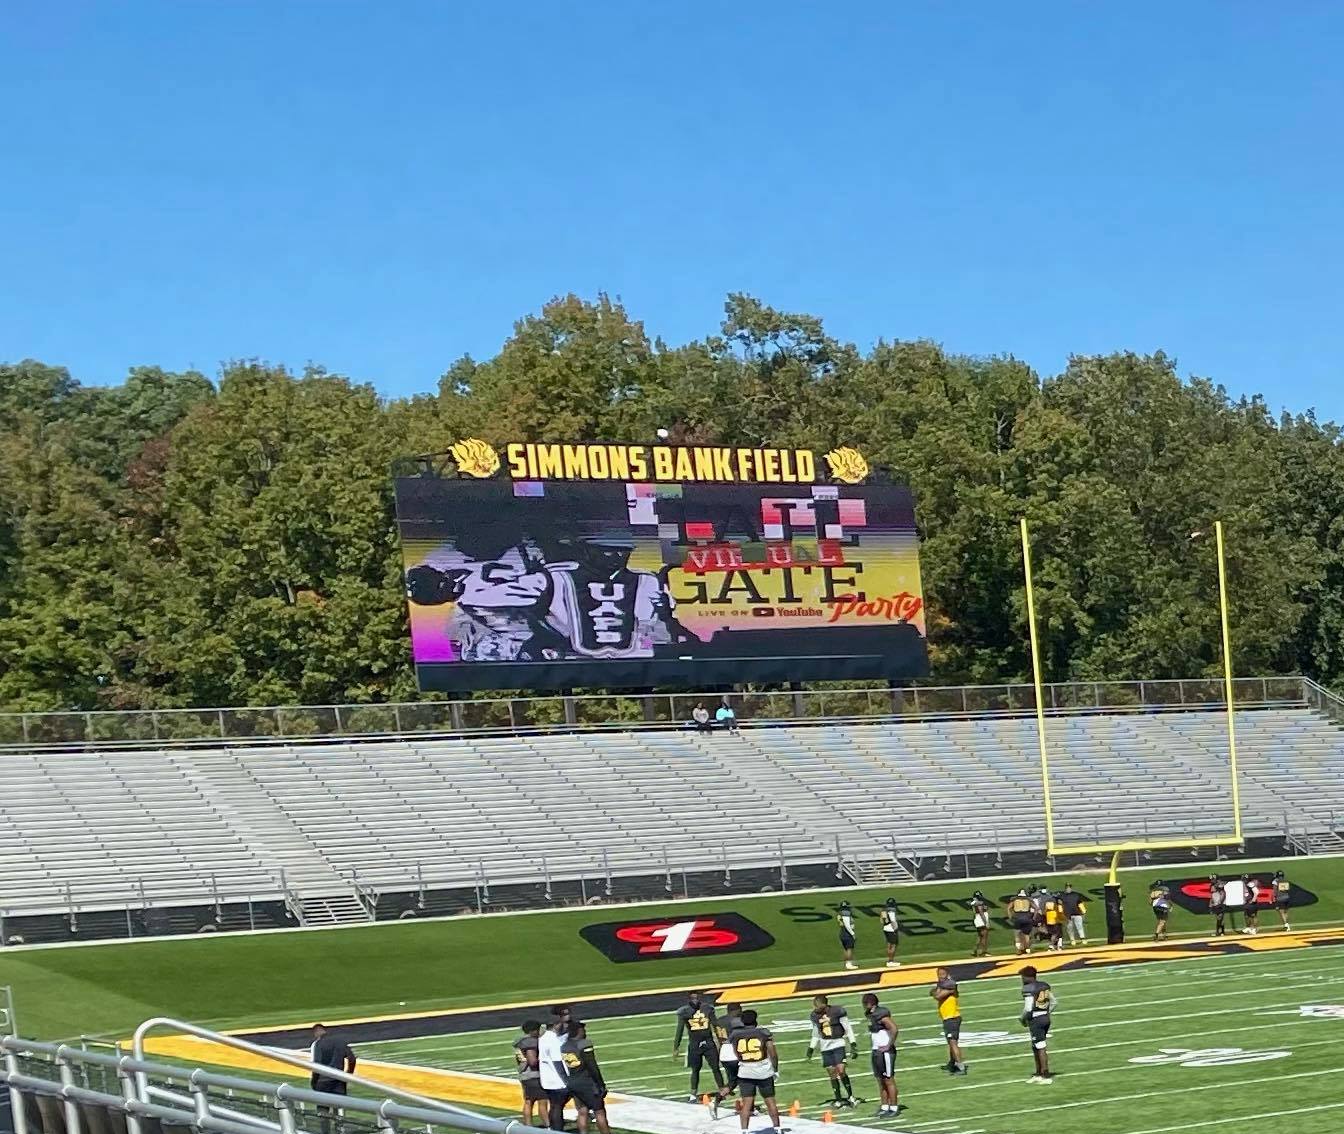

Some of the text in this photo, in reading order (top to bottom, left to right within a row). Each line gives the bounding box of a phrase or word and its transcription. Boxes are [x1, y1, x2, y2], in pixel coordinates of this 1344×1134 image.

[507, 443, 815, 482] SIMMONS BANK FIELD
[661, 562, 866, 604] GATE
[776, 607, 823, 618] YouTube
[827, 592, 922, 622] Party
